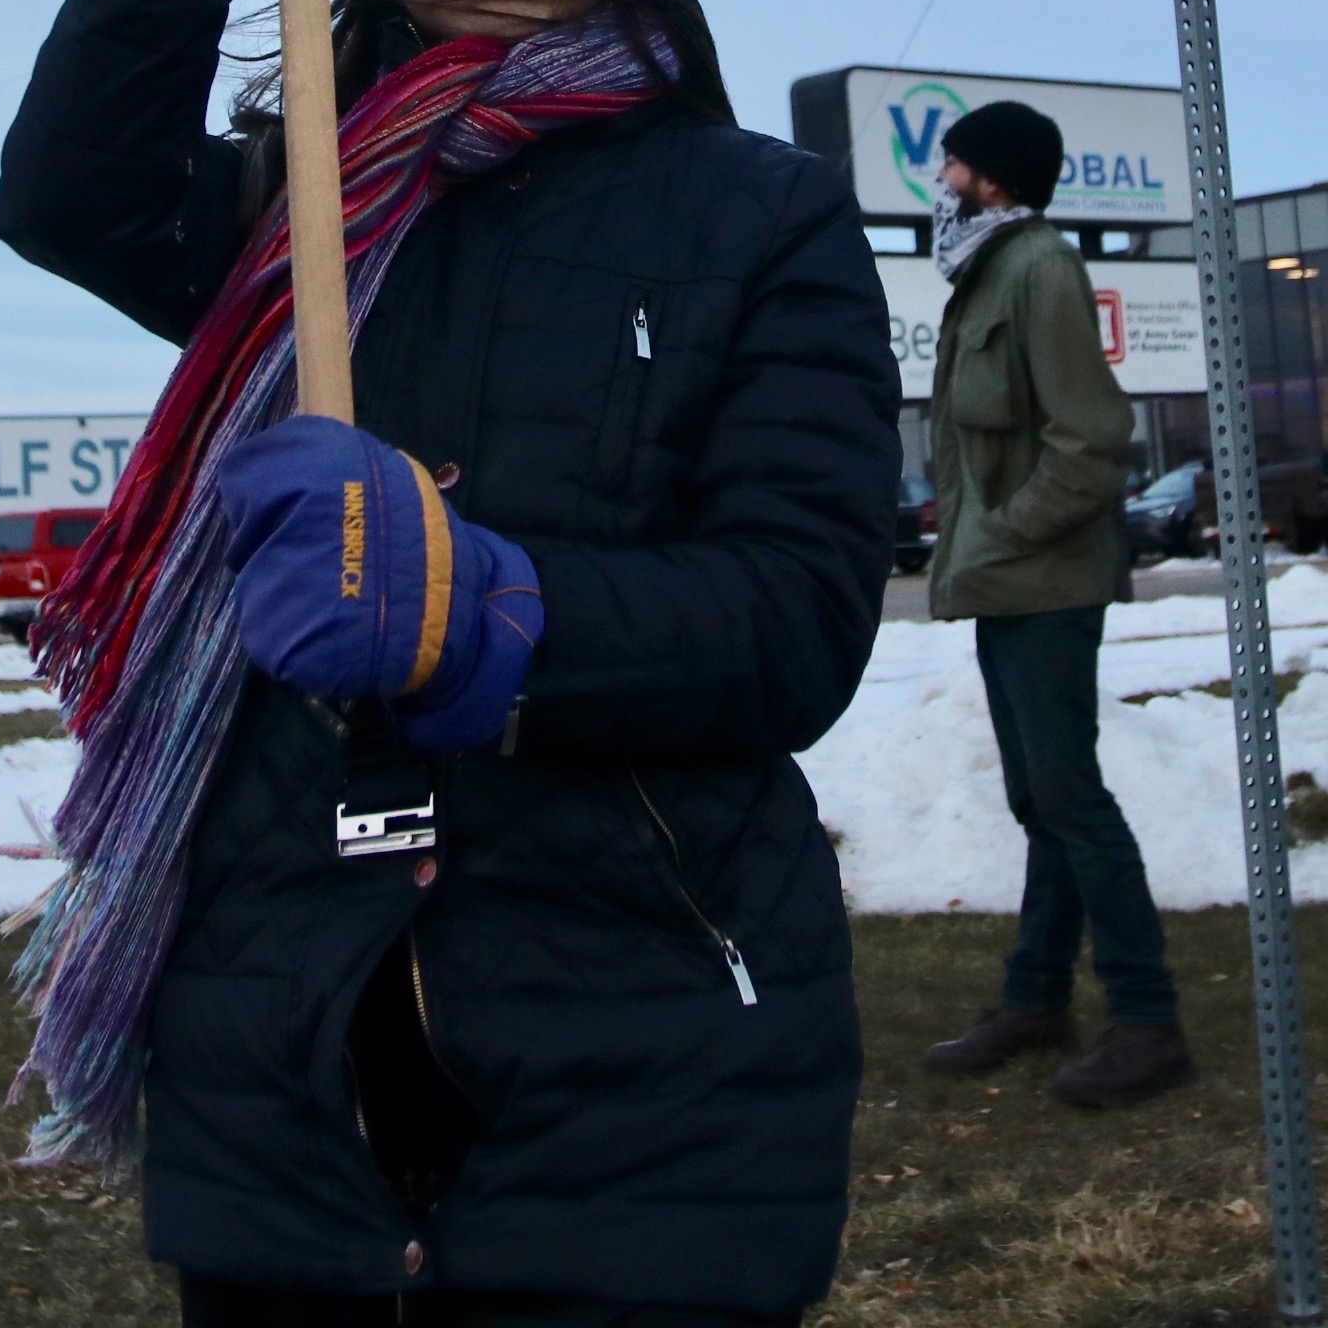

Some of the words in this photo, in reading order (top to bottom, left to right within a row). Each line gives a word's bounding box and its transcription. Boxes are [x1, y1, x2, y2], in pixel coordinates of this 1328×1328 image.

[1058, 153, 1164, 189] OBAL
[890, 315, 934, 362] Be
[69, 437, 130, 496] ST
